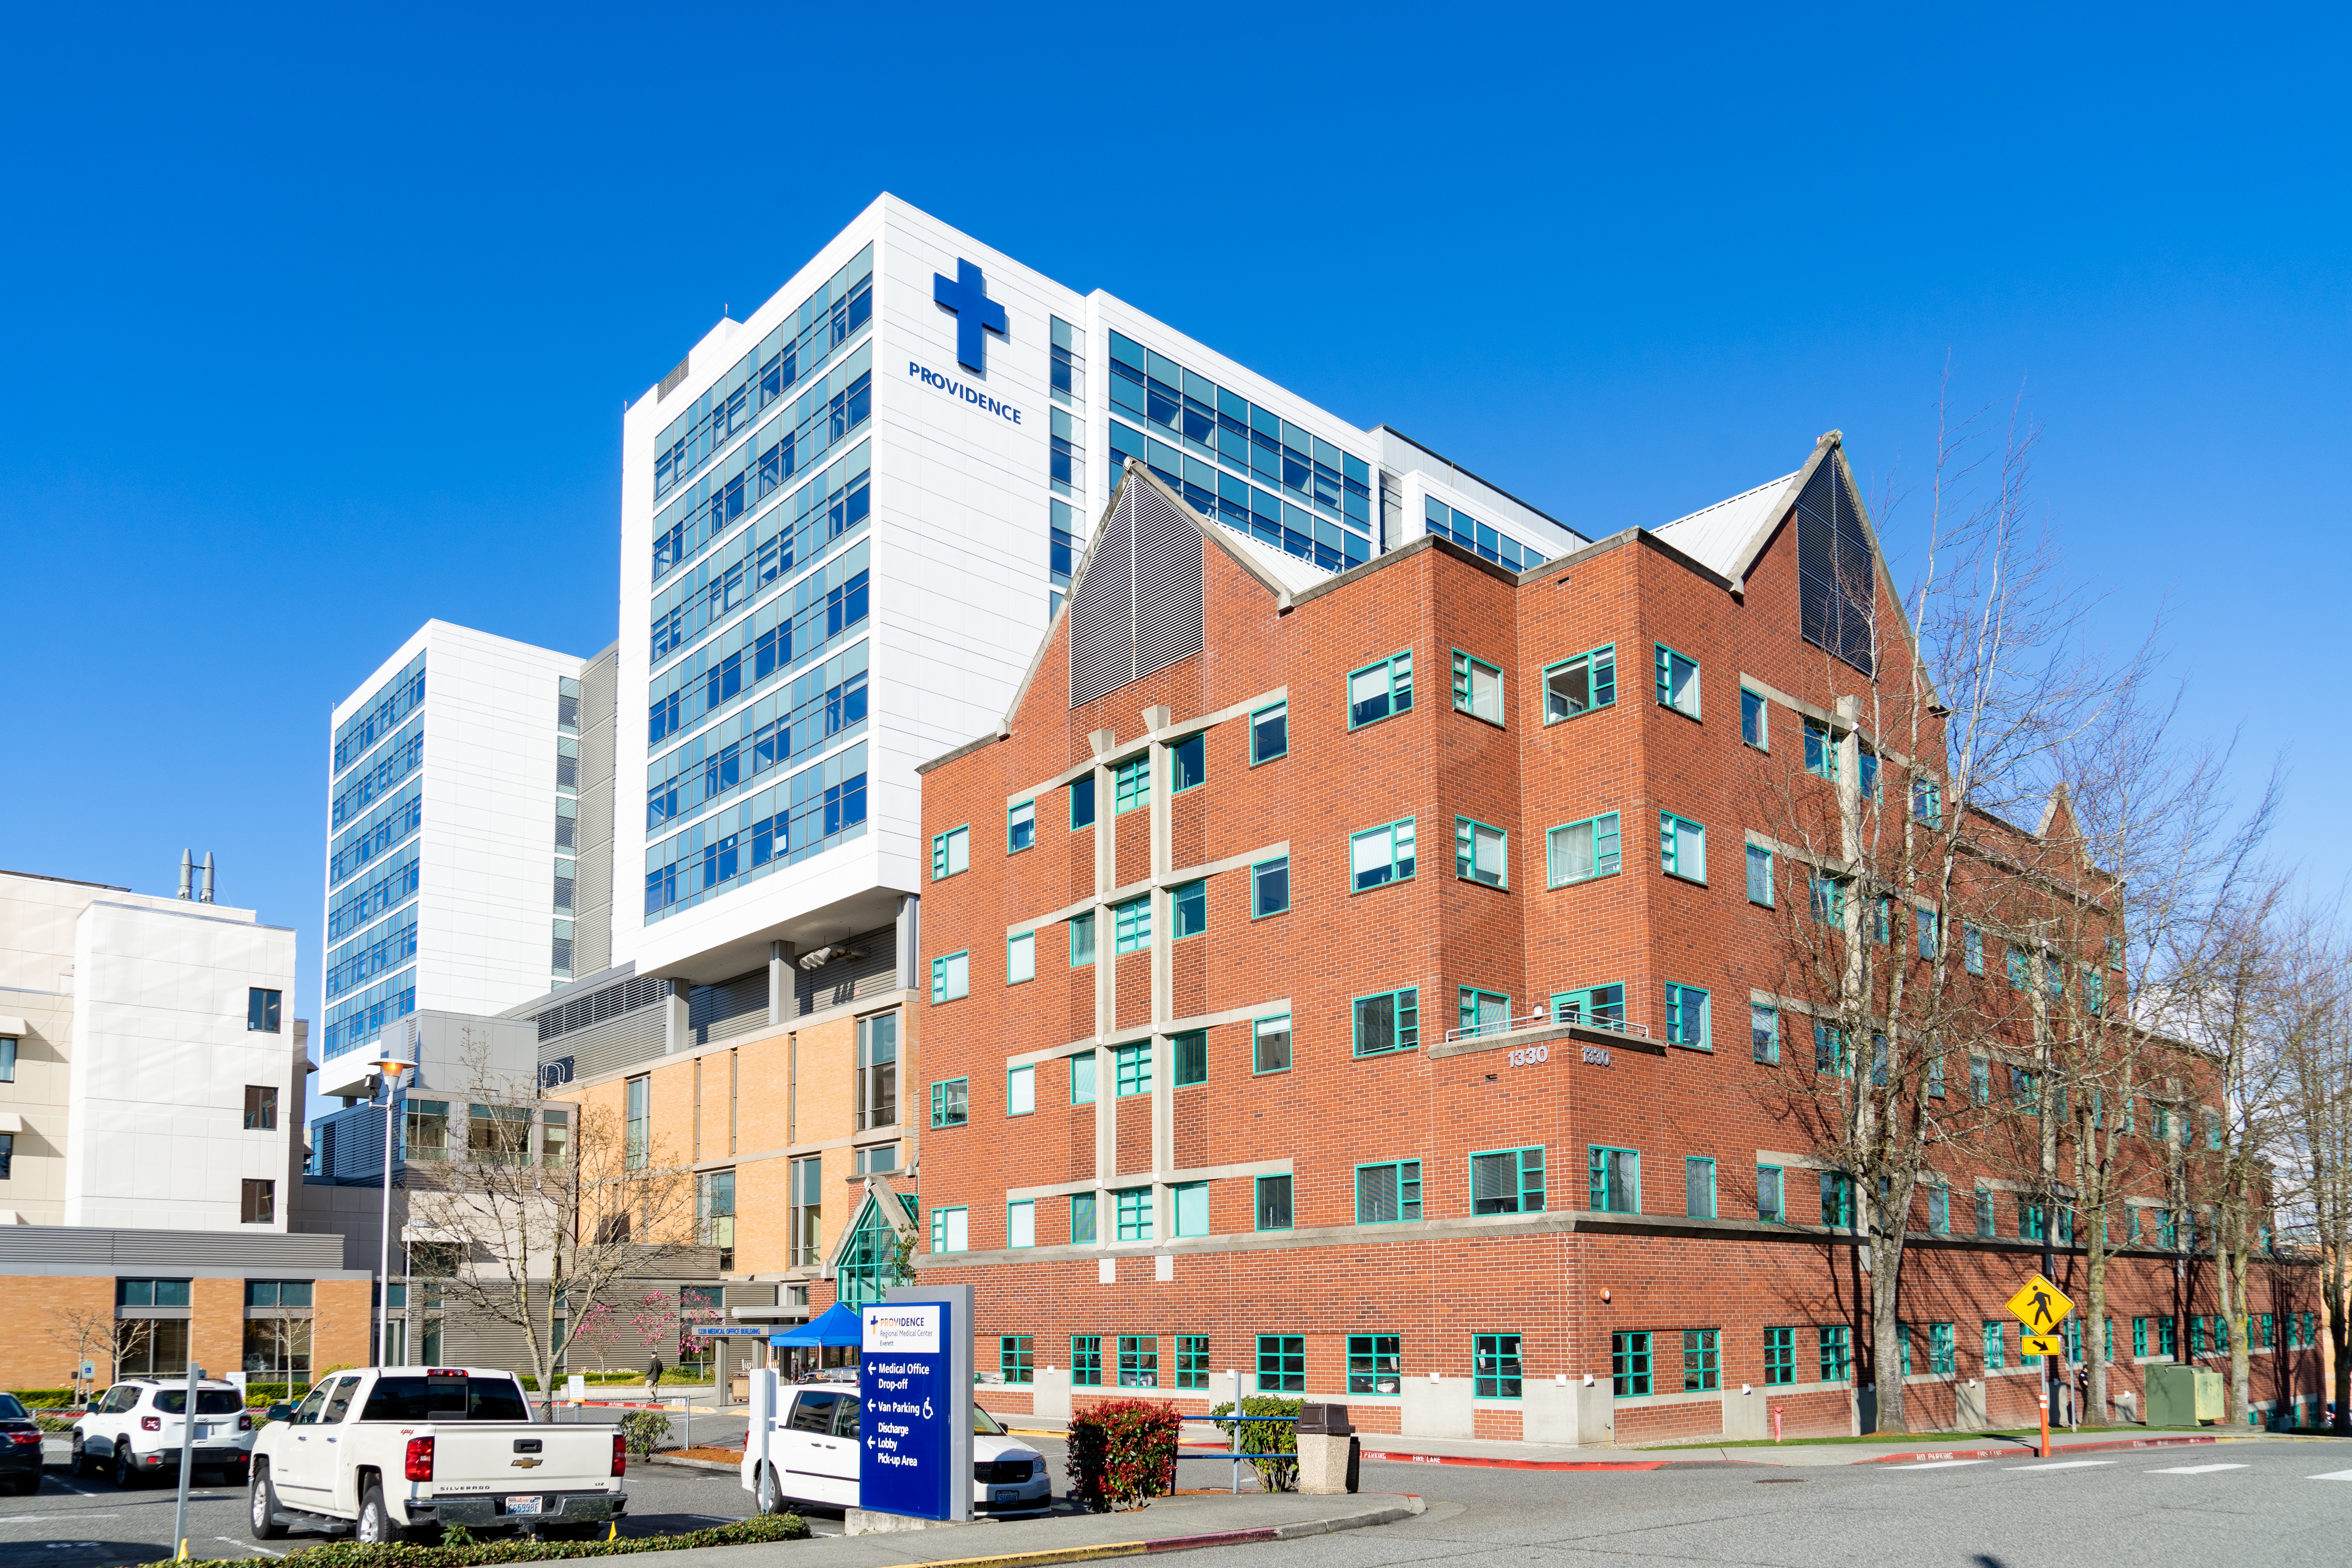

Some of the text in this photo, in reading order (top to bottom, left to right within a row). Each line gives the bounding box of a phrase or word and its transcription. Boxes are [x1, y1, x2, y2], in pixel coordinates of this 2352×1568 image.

[909, 361, 1021, 425] PROVIDENCE
[1508, 1045, 1548, 1068] 1330
[1582, 1046, 1610, 1066] 1330
[880, 1317, 924, 1327] PROVIDENCE
[880, 1330, 898, 1339] Regional
[879, 1363, 929, 1374] Medical Office
[878, 1378, 908, 1391] Drop-off
[878, 1401, 920, 1416] Van Parking
[878, 1422, 909, 1437] Discharge
[878, 1437, 897, 1452] Lobby
[878, 1452, 917, 1467] Pick-up Area
[1928, 1452, 1953, 1461] PARKING
[508, 1503, 539, 1513] C65998F
